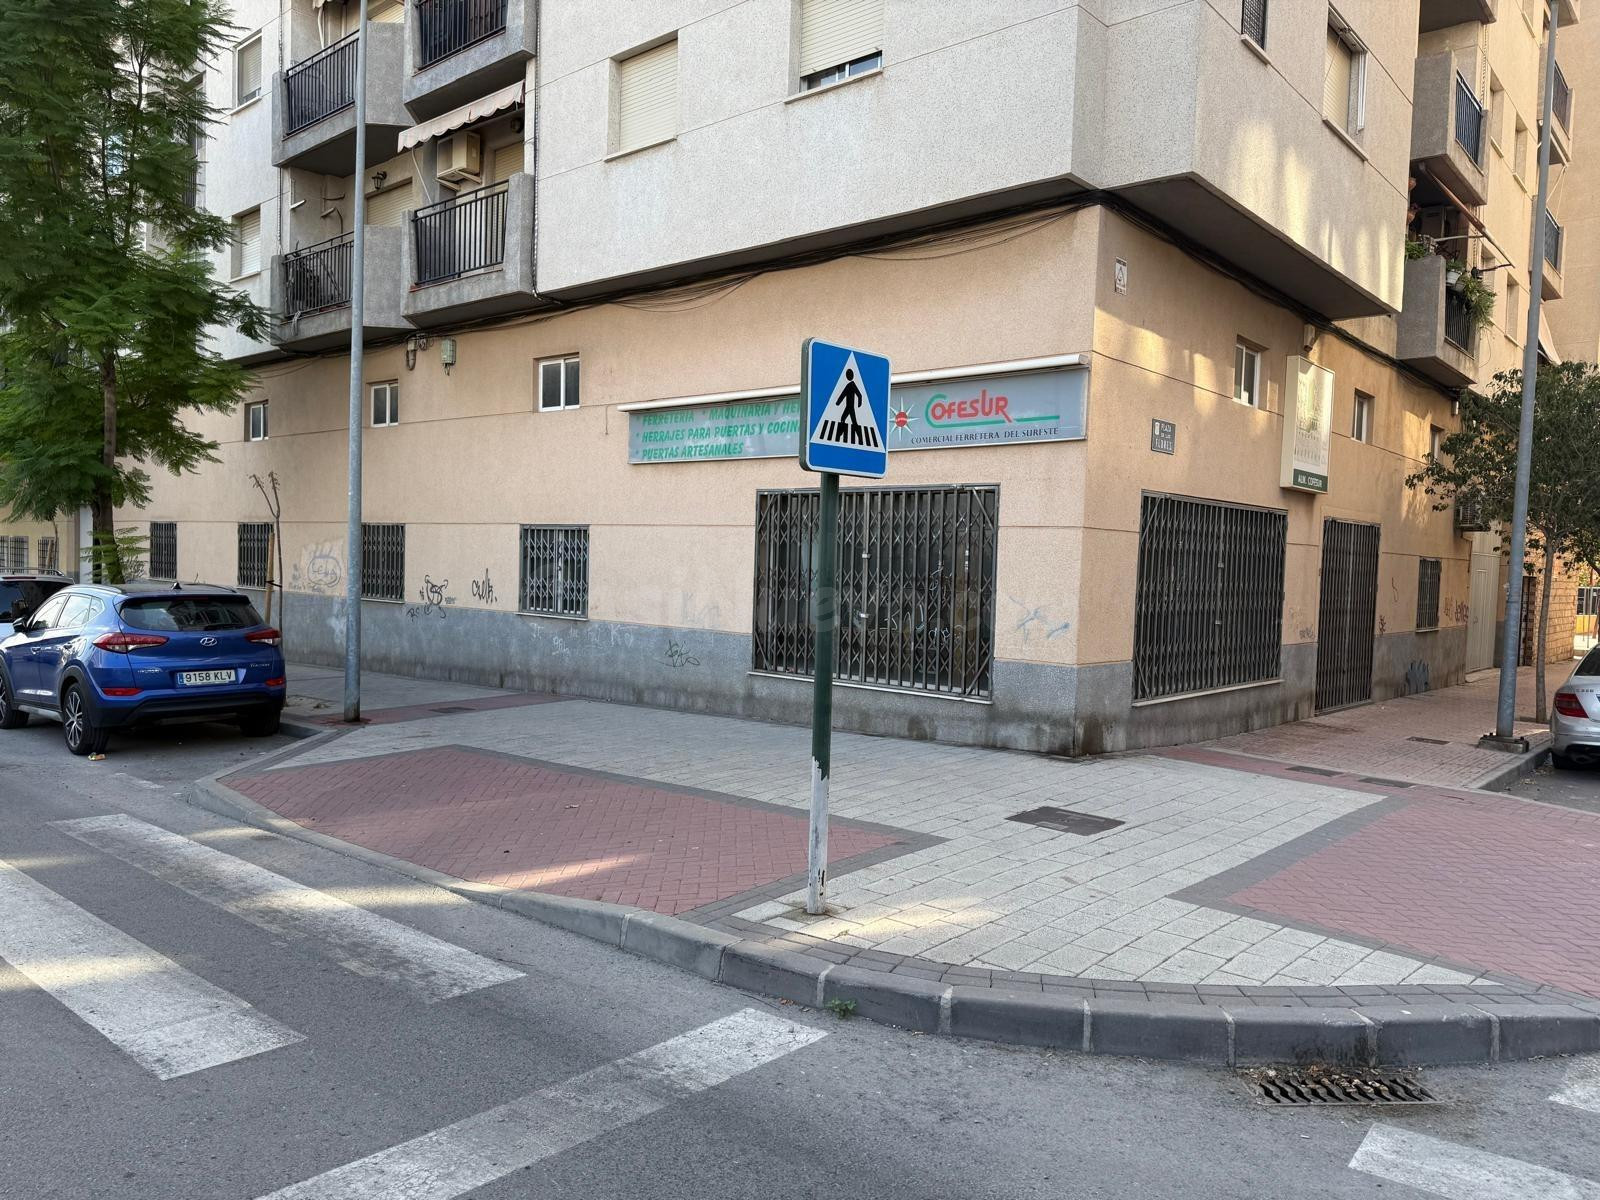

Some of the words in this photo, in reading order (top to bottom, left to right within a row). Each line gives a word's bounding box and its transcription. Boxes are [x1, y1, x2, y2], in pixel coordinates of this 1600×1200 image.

[709, 402, 771, 421] MAQUINARIA
[925, 389, 1012, 428] COFESUR
[641, 428, 686, 443] HERRAJES
[687, 427, 711, 441] PARA
[714, 422, 756, 438] PUERTAS
[758, 422, 765, 435] Y
[767, 419, 801, 434] COCIN
[911, 434, 952, 445] COMERCIAL
[955, 431, 1000, 442] FERRETERA
[1004, 430, 1019, 439] DEL
[1022, 427, 1059, 437] SURESTE
[642, 446, 679, 460] PUERTAS
[681, 442, 744, 459] ARTESANALES
[185, 672, 211, 683] 9158
[213, 671, 232, 681] KLV
